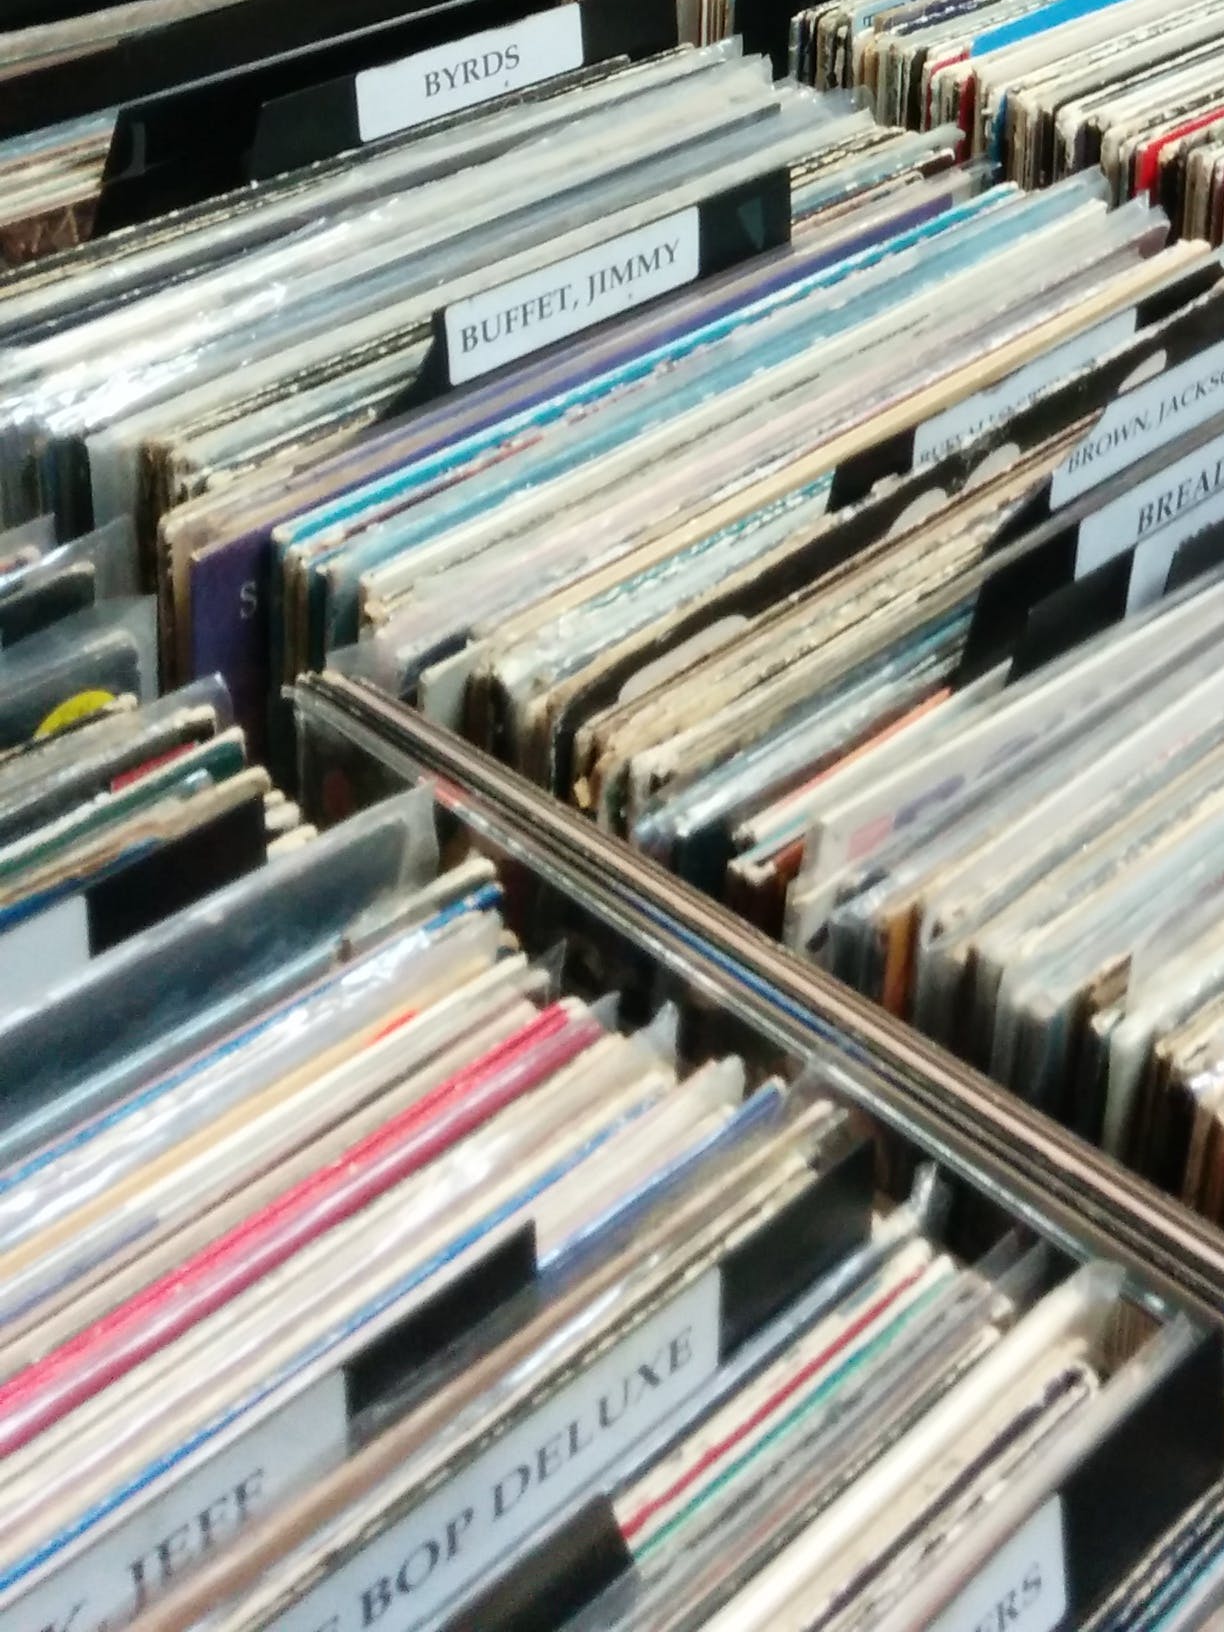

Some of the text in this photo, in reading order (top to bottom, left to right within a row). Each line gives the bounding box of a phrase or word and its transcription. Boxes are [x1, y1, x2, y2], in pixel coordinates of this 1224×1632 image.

[423, 43, 521, 98] BYRDS
[459, 237, 681, 355] BUFFET, JIMMY
[129, 1467, 267, 1616] JEFF
[357, 1324, 694, 1628] BOP DELUXE
